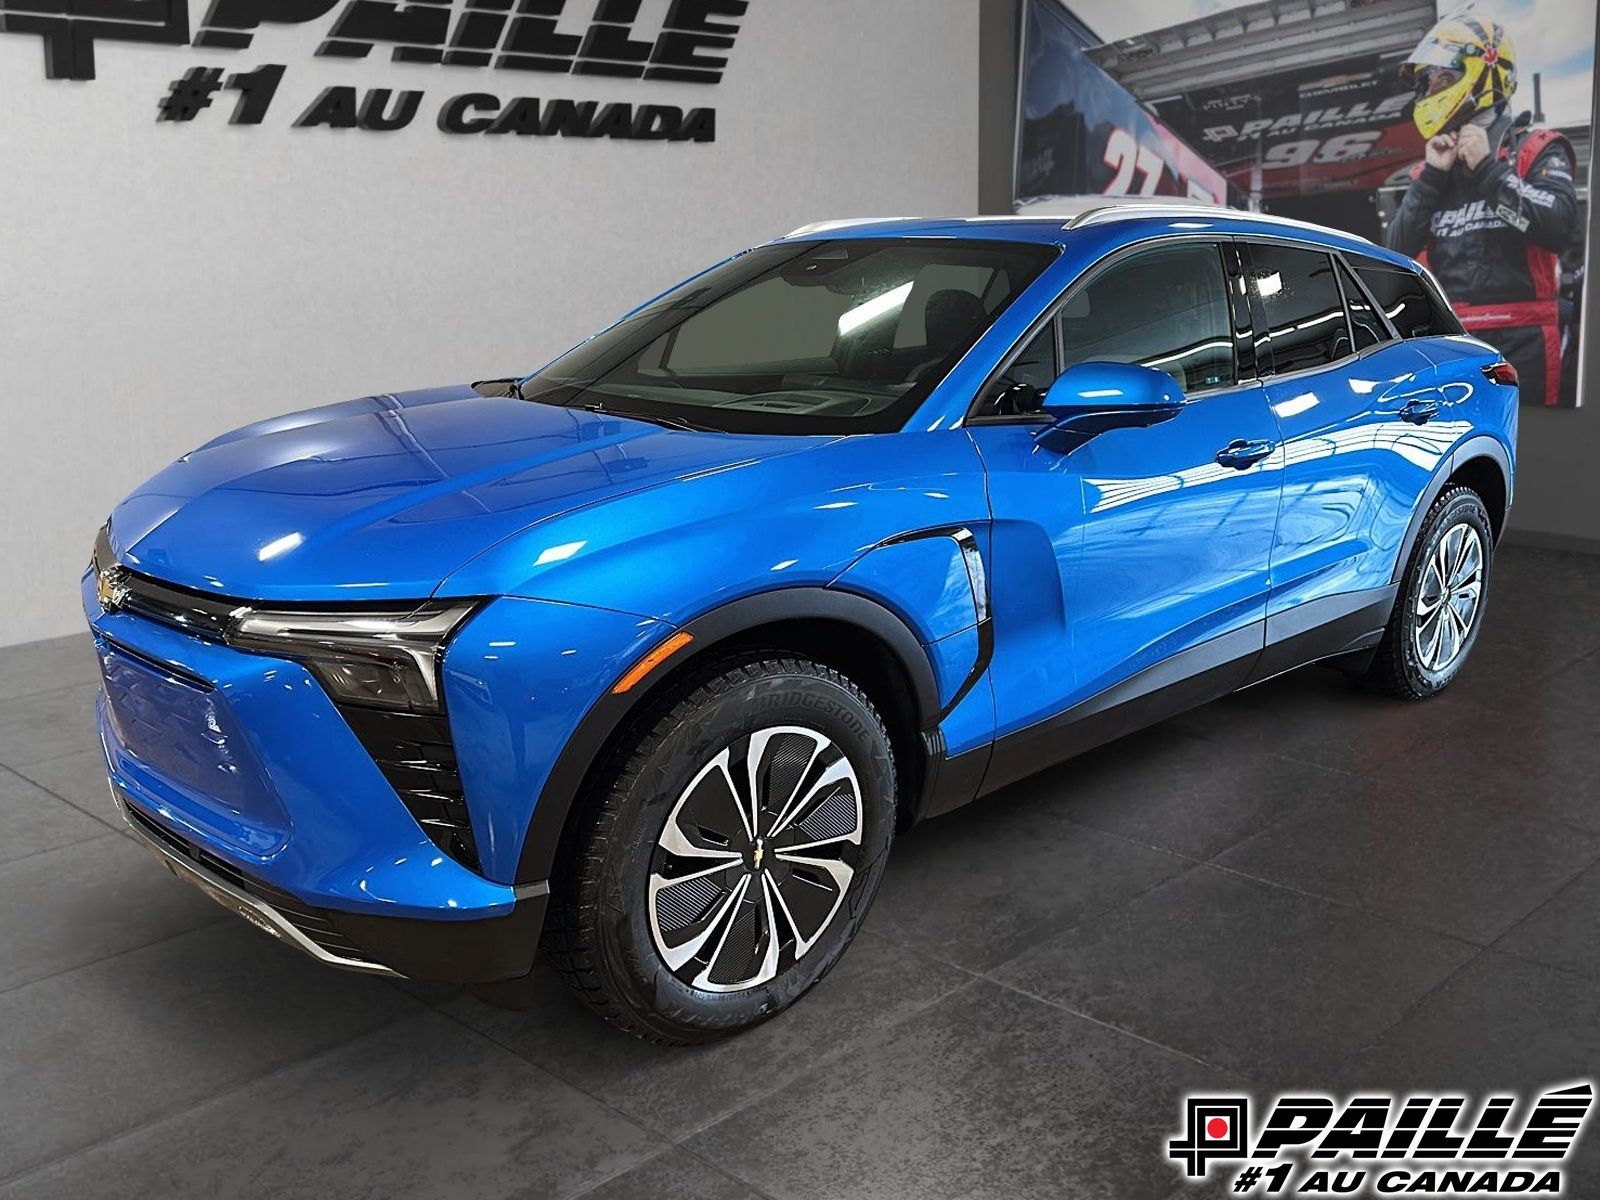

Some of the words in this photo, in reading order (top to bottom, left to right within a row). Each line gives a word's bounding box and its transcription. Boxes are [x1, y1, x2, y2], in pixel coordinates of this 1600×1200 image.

[156, 64, 287, 125] #1
[291, 86, 425, 131] AU
[437, 93, 716, 143] CANADA
[1267, 127, 1296, 138] AU
[1303, 112, 1401, 132] CANADA
[1101, 127, 1164, 196] 27
[1260, 131, 1383, 169] 96
[1438, 200, 1498, 230] PAIL
